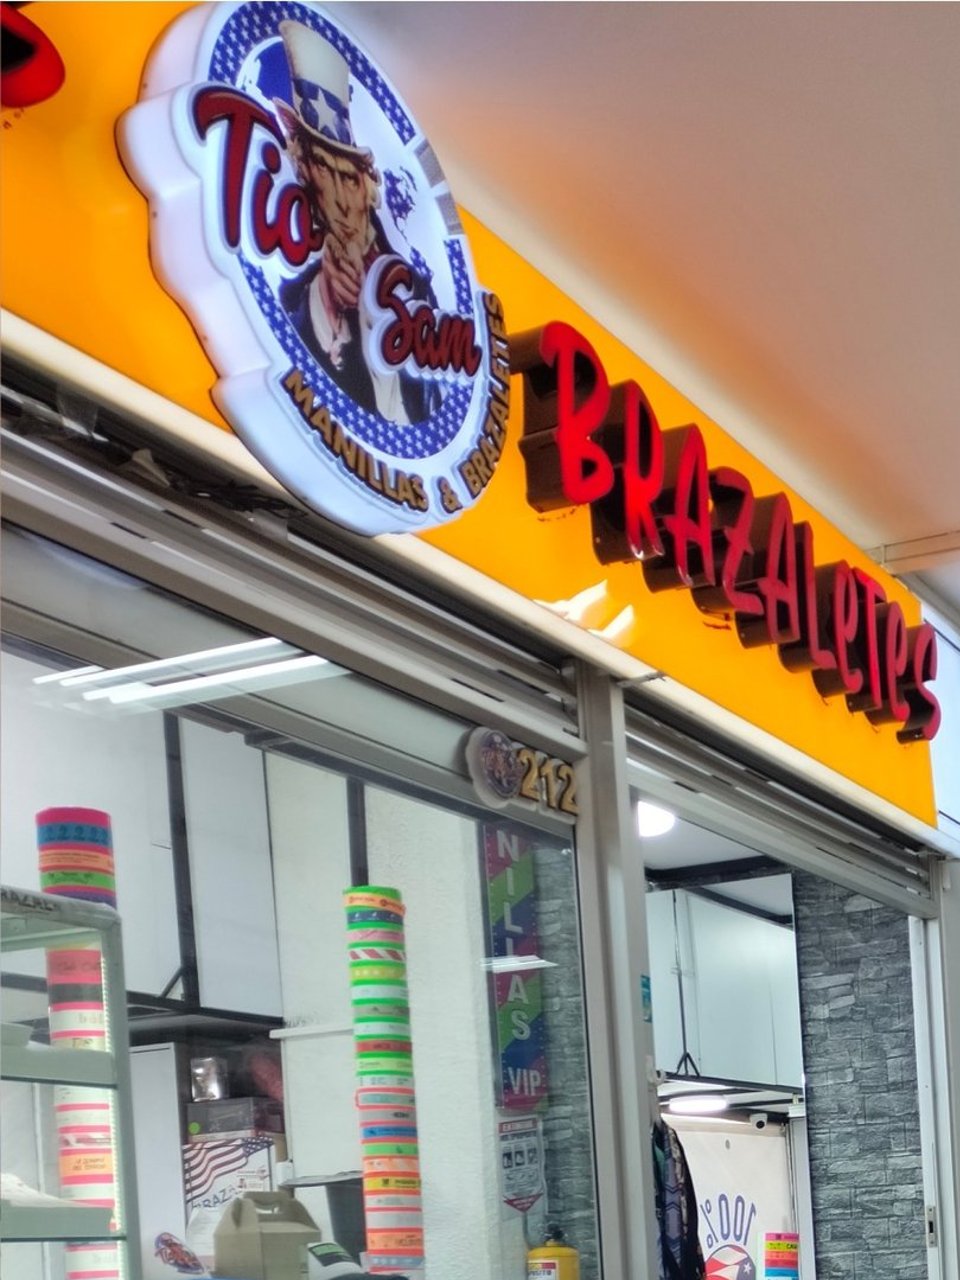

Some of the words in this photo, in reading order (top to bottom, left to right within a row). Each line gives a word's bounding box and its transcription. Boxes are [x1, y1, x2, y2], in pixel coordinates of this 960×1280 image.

[376, 258, 483, 378] Sam
[280, 367, 429, 514] MANILLAS
[437, 476, 462, 513] &
[459, 291, 511, 498] BRAZALETES
[516, 748, 578, 817] 212
[507, 1066, 541, 1097] VIP
